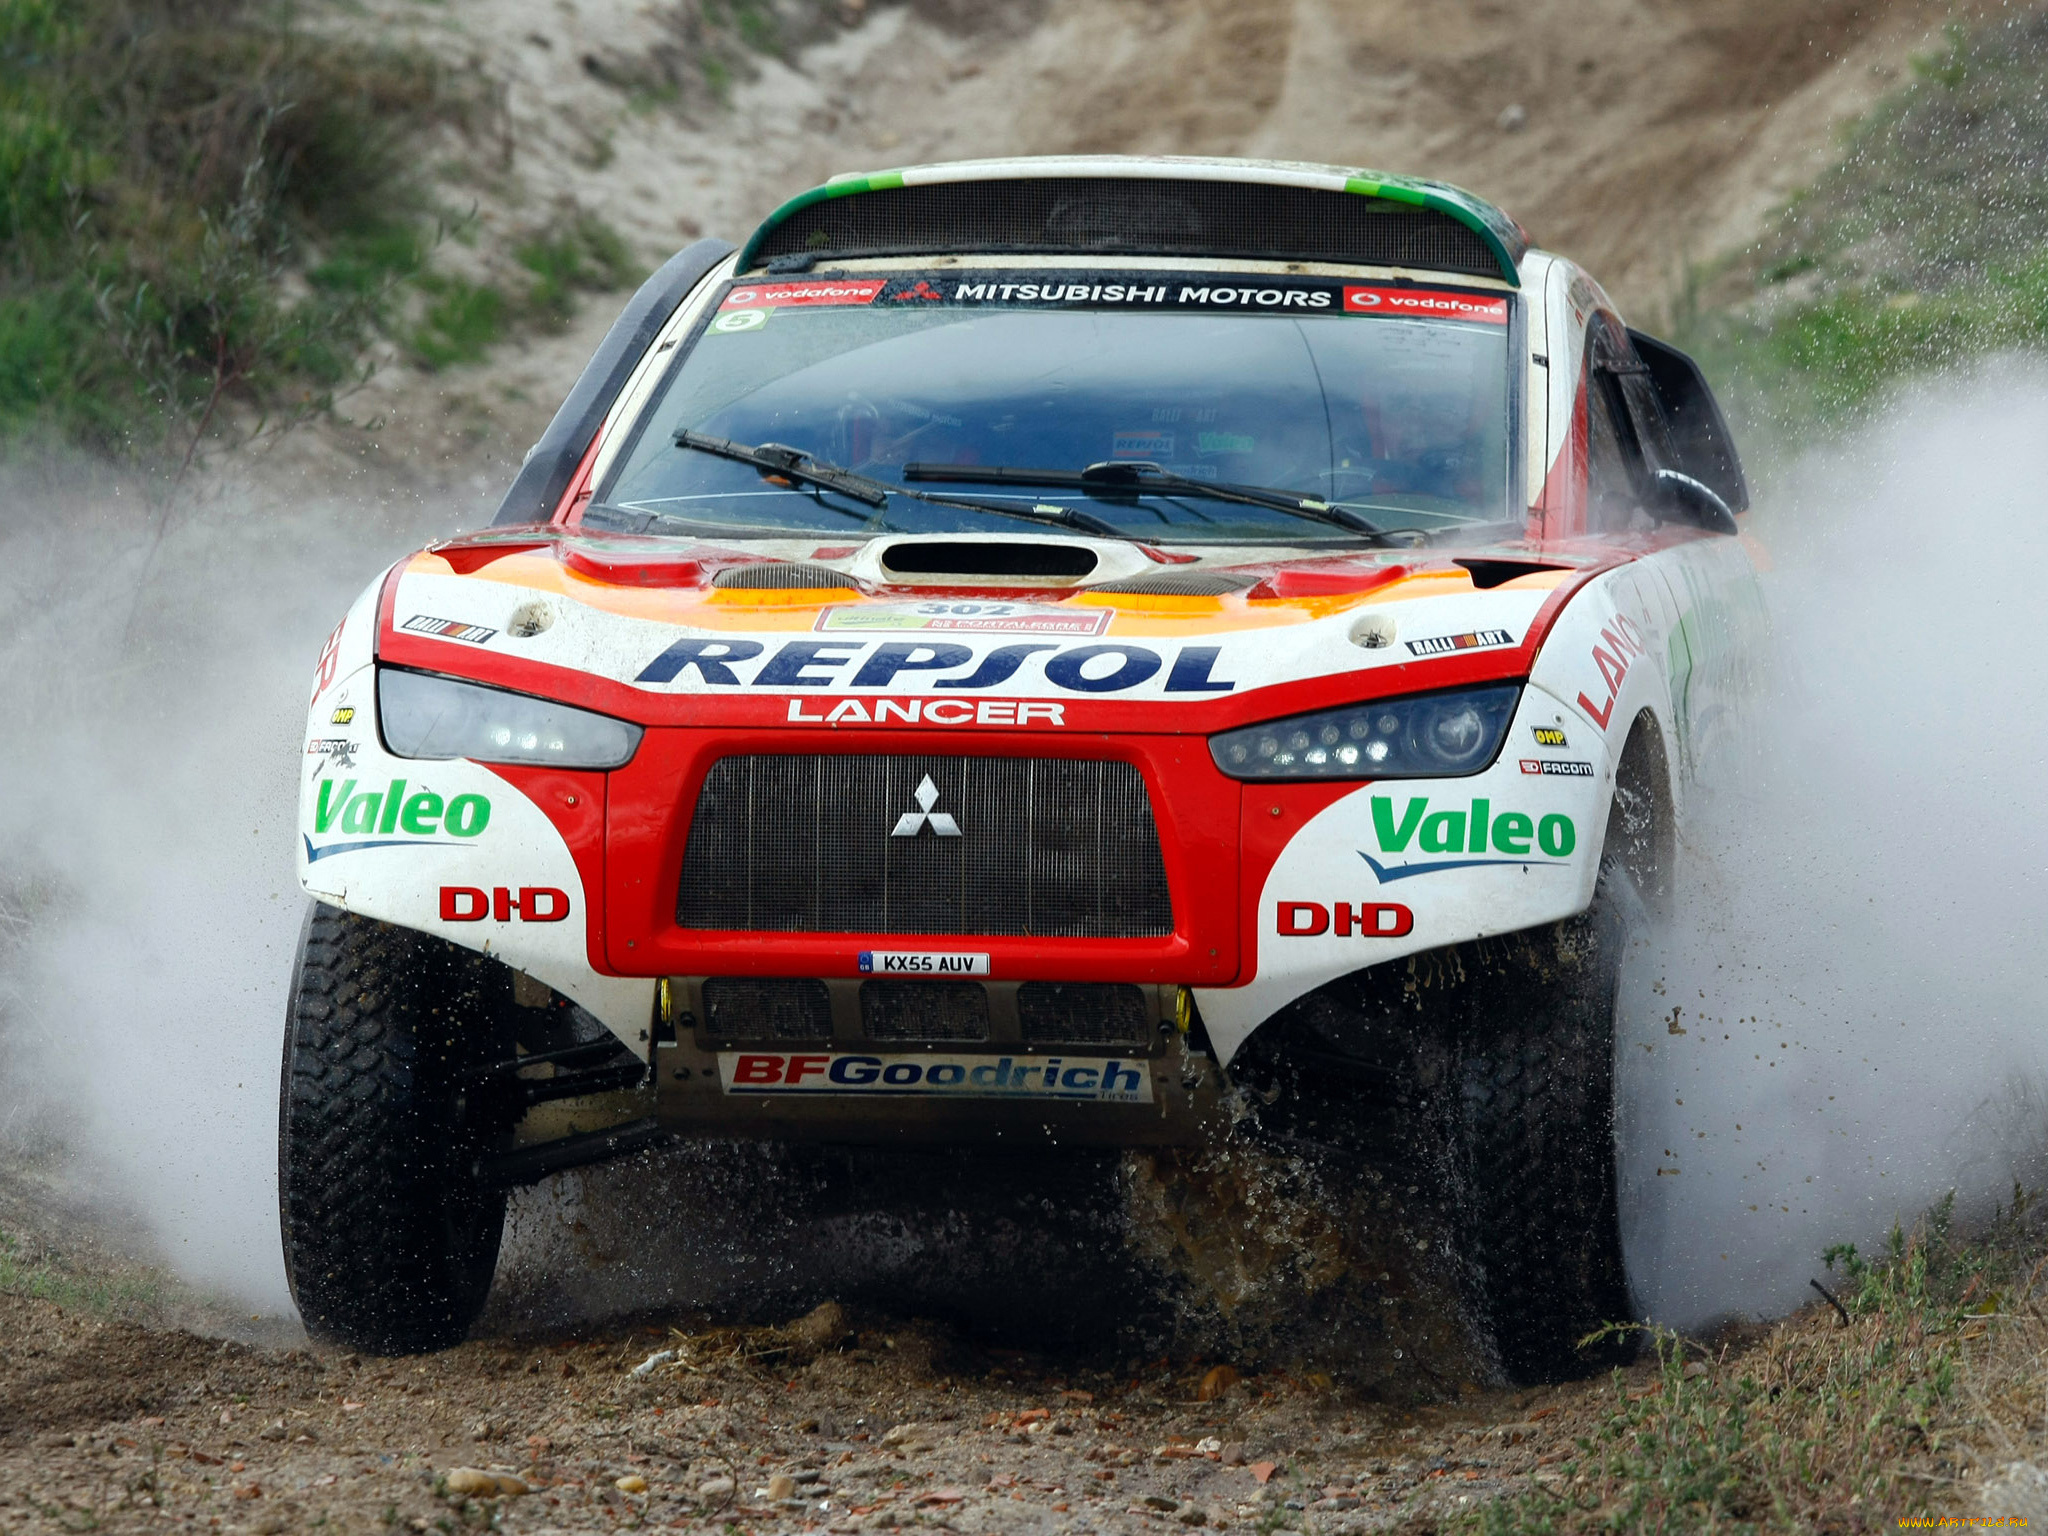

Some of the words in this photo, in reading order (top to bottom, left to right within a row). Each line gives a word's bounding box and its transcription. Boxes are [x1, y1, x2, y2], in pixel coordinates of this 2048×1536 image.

[765, 287, 873, 300] vodafone
[955, 283, 1166, 303] MITSUBISHI
[1178, 287, 1331, 307] MOTORS
[1389, 296, 1503, 315] vodafone
[917, 602, 1014, 616] 302
[1412, 637, 1455, 655] RALLI
[1476, 630, 1506, 646] ART
[633, 637, 1236, 692] REPSOL
[786, 699, 1065, 726] LANCER
[1542, 761, 1593, 775] FACOM
[314, 779, 491, 838] Valeo
[1369, 796, 1576, 857] Valeo
[884, 955, 933, 971] KX55
[938, 956, 974, 972] AUV
[733, 1054, 1142, 1092] BFGoodrich
